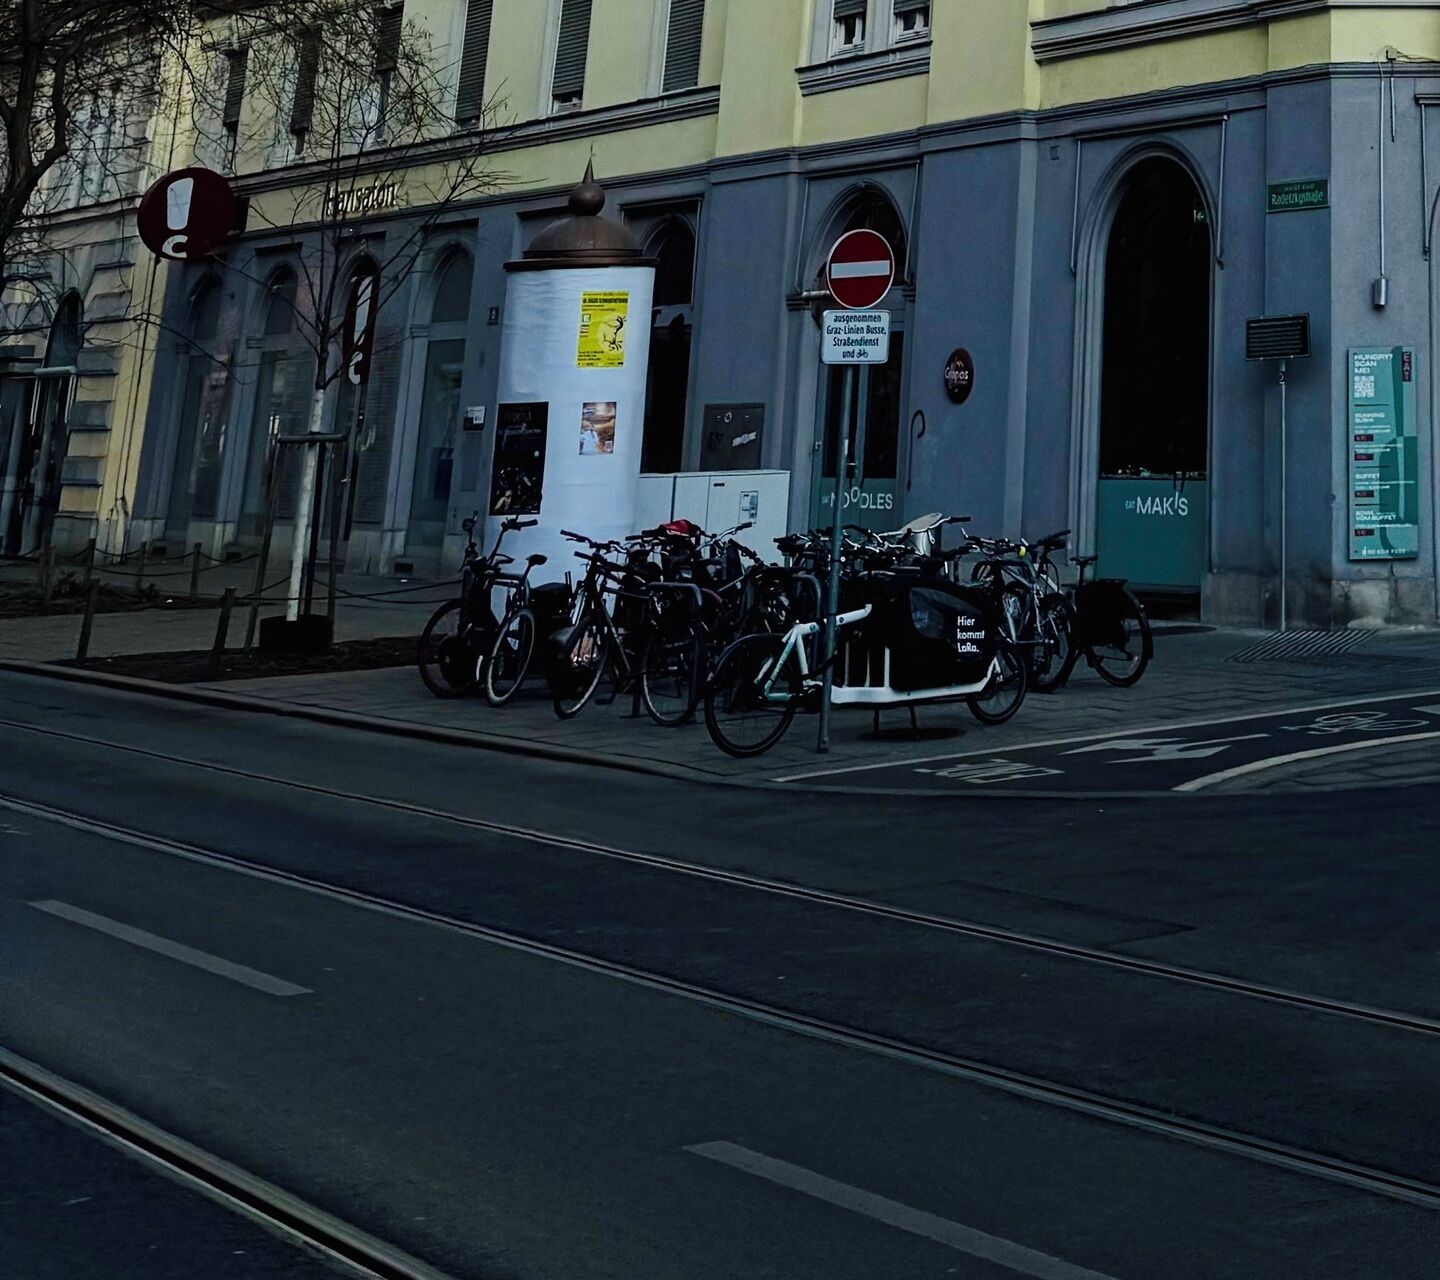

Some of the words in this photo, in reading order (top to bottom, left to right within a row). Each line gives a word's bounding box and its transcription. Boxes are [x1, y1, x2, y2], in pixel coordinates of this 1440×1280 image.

[833, 314, 882, 324] ausgenommen
[866, 325, 887, 335] Busse,
[833, 336, 880, 347] Straßendienst
[842, 349, 855, 358] und
[1136, 491, 1188, 516] MAKIS
[957, 615, 976, 626] Hier
[957, 628, 985, 640] kommt
